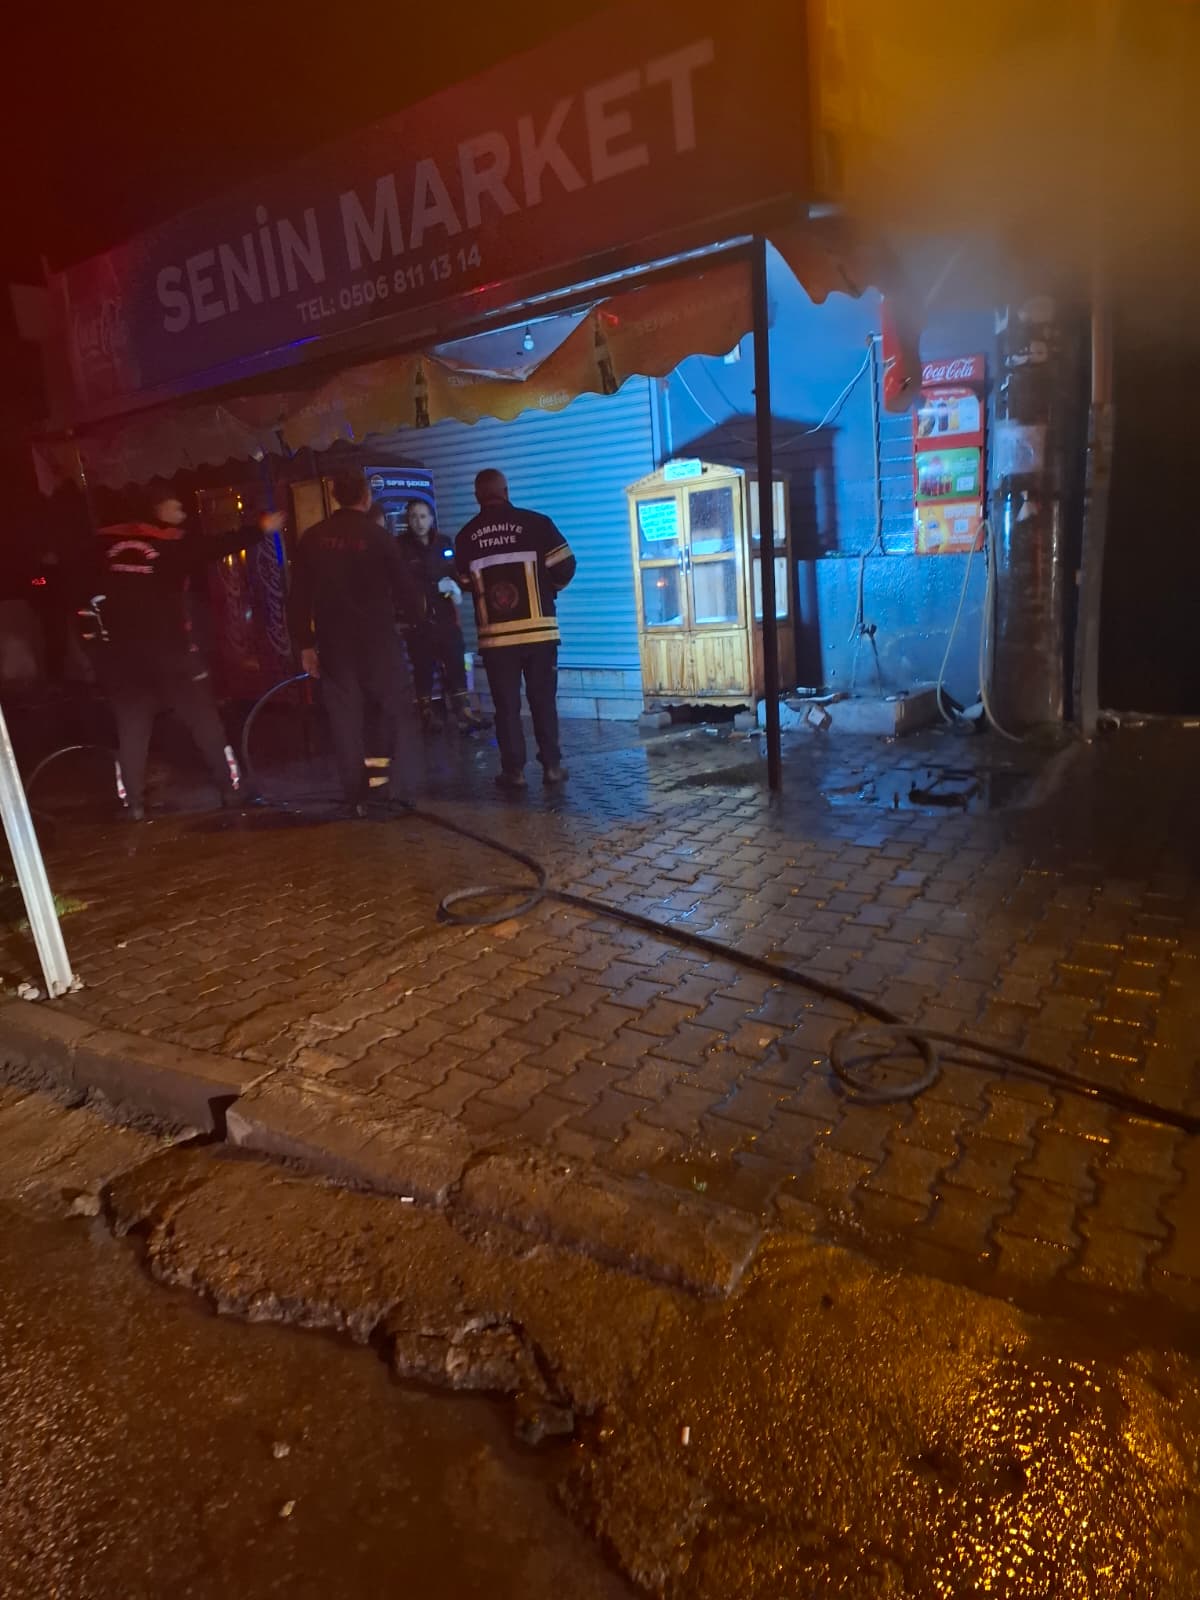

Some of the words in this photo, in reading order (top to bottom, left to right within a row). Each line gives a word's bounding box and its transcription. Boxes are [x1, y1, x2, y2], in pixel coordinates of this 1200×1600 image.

[155, 204, 327, 335] SENİN
[339, 36, 717, 272] MARKET
[296, 295, 336, 325] TEL:
[340, 275, 389, 312] 0506
[393, 263, 426, 293] 811
[427, 252, 454, 282] 13
[456, 242, 483, 273] 14
[471, 522, 524, 541] OSMANİYE
[479, 535, 517, 548] İTFAİYE
